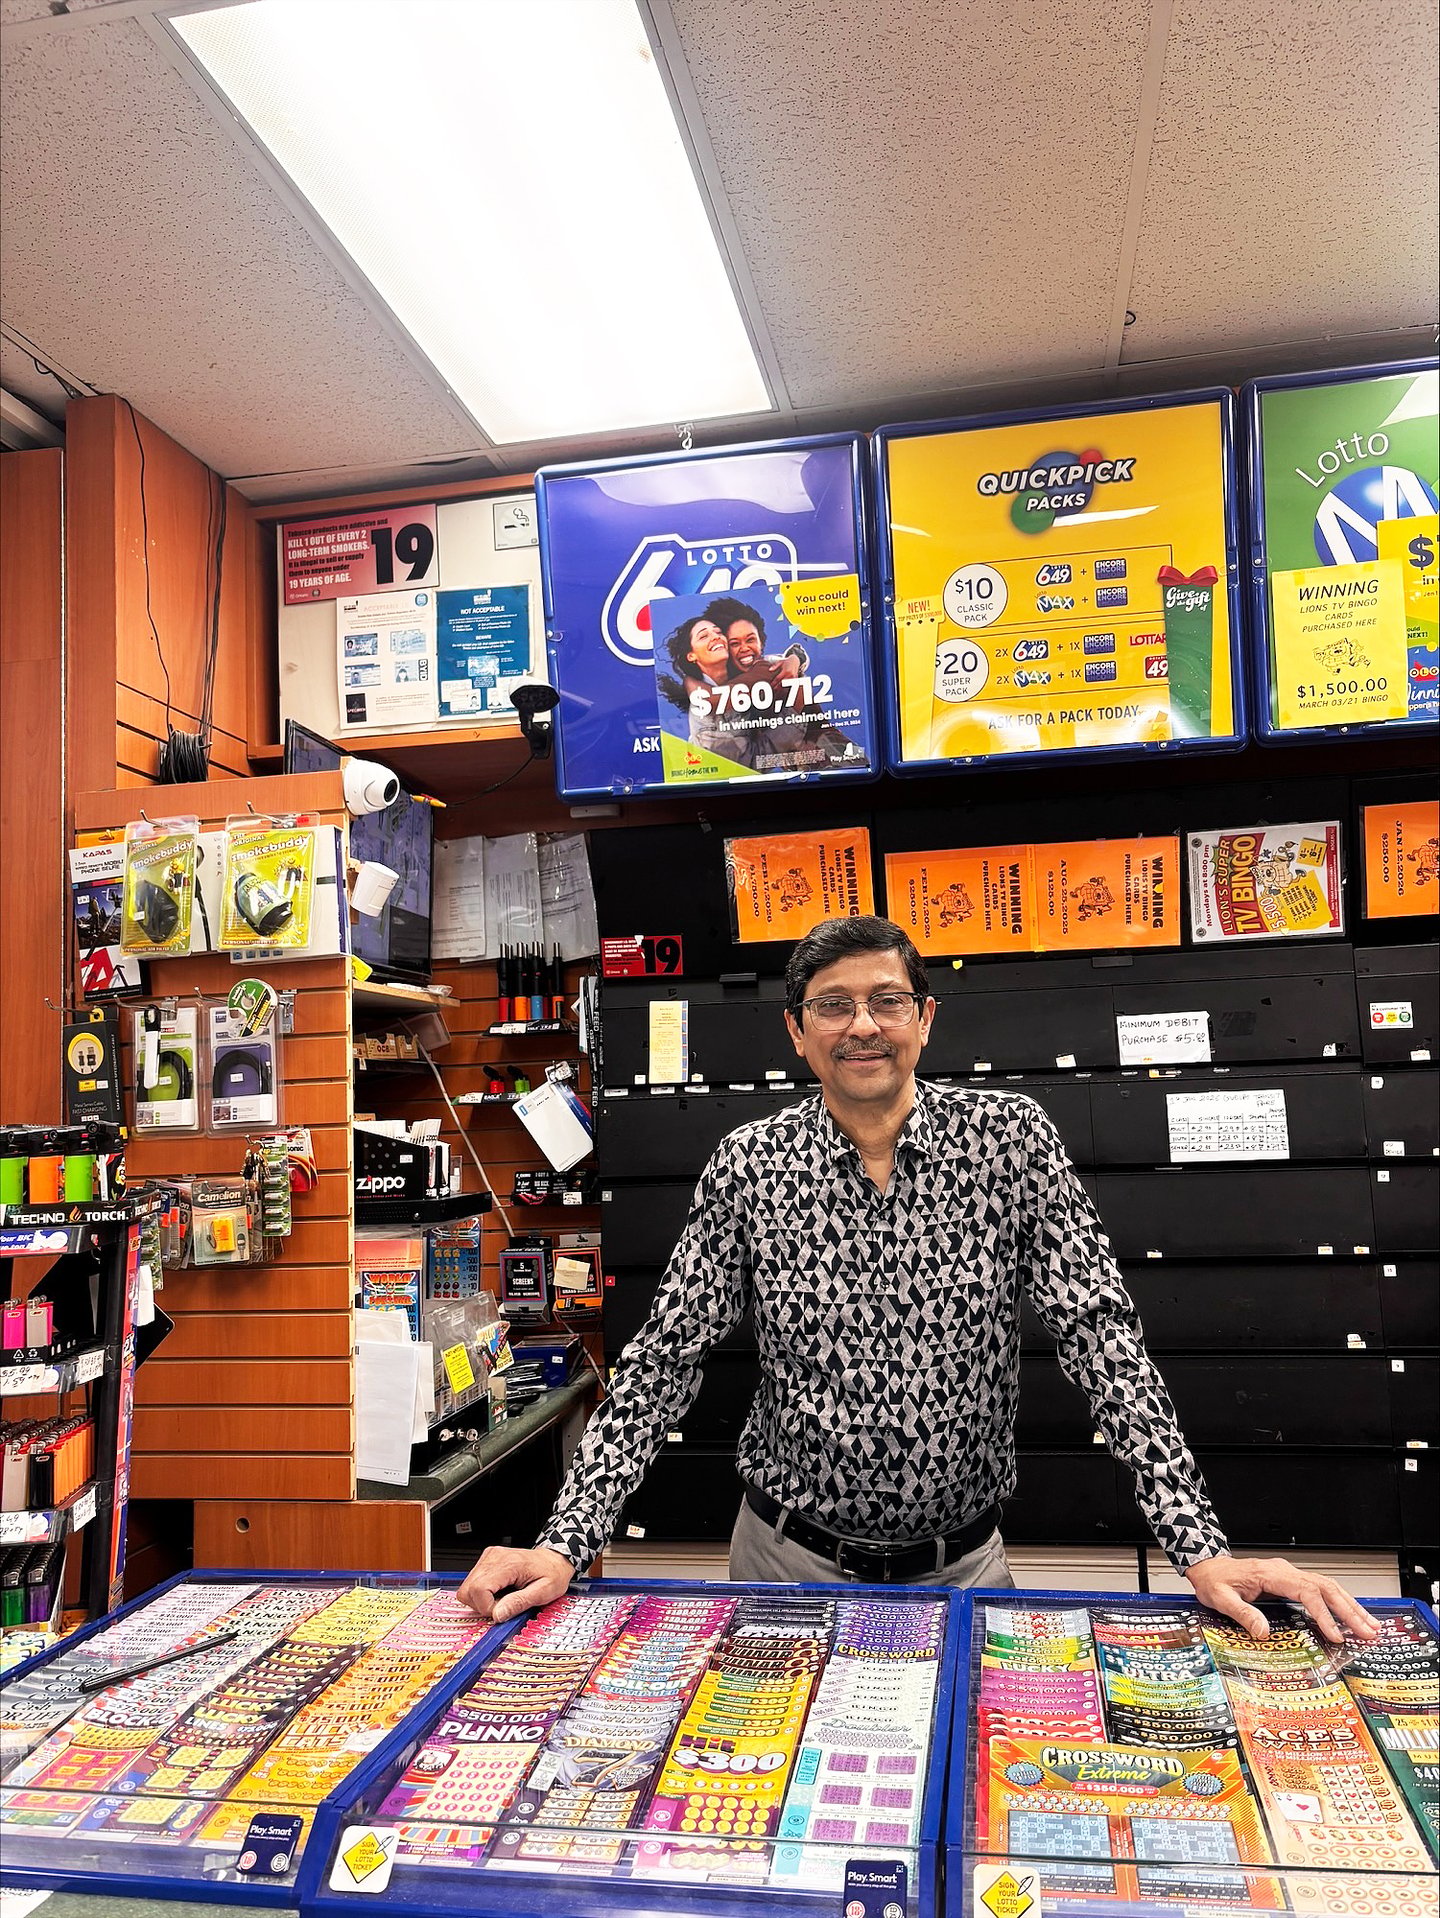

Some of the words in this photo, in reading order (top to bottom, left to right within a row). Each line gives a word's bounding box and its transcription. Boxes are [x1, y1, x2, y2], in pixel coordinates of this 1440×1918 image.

[1296, 431, 1389, 488] Lotto
[978, 458, 1136, 496] QUICKPICK
[1027, 493, 1085, 512] PACKS
[288, 536, 302, 549] KILL
[305, 535, 309, 546] 1
[310, 534, 324, 546] OUT
[327, 533, 336, 544] OF
[337, 530, 360, 543] EVERY
[361, 529, 367, 539] 2
[288, 545, 330, 560] LONG-TERM
[331, 540, 370, 554] SMOKERS.
[371, 523, 434, 584] 19
[686, 543, 773, 567] LOTTO
[1096, 559, 1125, 569] ENCORE
[289, 580, 299, 589] 19
[299, 576, 324, 588] YEARS
[324, 575, 334, 584] OF
[335, 573, 352, 584] AGE.
[1422, 575, 1435, 586] in
[956, 577, 993, 601] $10
[1097, 587, 1126, 596] ENCORE
[1299, 579, 1379, 601] WINNING
[796, 595, 816, 604] You
[819, 590, 849, 601] could
[1037, 595, 1074, 613] MAX
[1166, 587, 1196, 608] Give
[1185, 591, 1211, 612] gift
[472, 605, 505, 614] ACCEPTABLE
[796, 608, 815, 616] win
[819, 602, 846, 613] next!
[908, 600, 930, 614] NEW!
[957, 603, 994, 613] CLASSIC
[1300, 604, 1328, 614] LIONS
[1332, 602, 1345, 610] TV
[1348, 598, 1378, 609] BINGO
[964, 614, 988, 623] PACK
[1325, 612, 1354, 621] CARDS
[1302, 621, 1353, 633] PURCHASED
[1355, 618, 1377, 627] HERE
[1085, 634, 1113, 642] ENCORE
[1407, 631, 1428, 639] NEXT!
[995, 649, 1009, 658] 2X
[1070, 642, 1080, 651] 1X
[935, 651, 978, 675] $20
[1071, 669, 1081, 678] 1X
[1409, 666, 1439, 678] OLG
[942, 677, 971, 687] SUPER
[997, 676, 1009, 685] 2X
[1014, 671, 1051, 688] MAX
[945, 688, 968, 696] PACK
[1297, 677, 1388, 699] $1,500.00
[689, 674, 833, 719] $760,712
[1299, 700, 1328, 710] MARCH
[1331, 697, 1358, 707] 03/21
[1362, 694, 1389, 704] BINGO
[719, 721, 731, 732] in
[732, 716, 783, 731] winnings
[784, 710, 832, 725] claimed
[833, 707, 860, 719] here
[989, 714, 1013, 730] ASK
[1018, 713, 1042, 726] FOR
[1047, 712, 1056, 724] A
[1060, 709, 1094, 723] PACK
[1097, 705, 1139, 720] TODAY
[633, 738, 660, 753] ASK
[82, 849, 112, 858] KAPAS
[231, 836, 308, 862] smokebuddy
[1203, 844, 1209, 858] pm
[819, 844, 828, 891] PURCHASED
[834, 849, 842, 873] LIONS
[1218, 840, 1231, 885] SUPER
[81, 867, 100, 875] PHONE
[1230, 835, 1257, 902] BINGO
[828, 866, 836, 893] CARDS
[836, 873, 843, 883] TV
[844, 846, 859, 916] WINNING
[982, 860, 990, 908] PURCHASED
[998, 866, 1006, 889] LIONS
[1202, 879, 1208, 888] at
[909, 879, 917, 925] $250.00
[1008, 863, 1022, 934] WINNING
[1203, 889, 1212, 927] Mondays
[1219, 889, 1233, 932] LION'S
[1260, 897, 1287, 929] 5,500
[1233, 908, 1261, 933] TV
[641, 937, 681, 974] 19
[1120, 1020, 1160, 1029] MINIMUM
[1164, 1018, 1199, 1028] DEBIT
[1121, 1033, 1168, 1046] PURCHASE
[356, 1175, 405, 1193] zippo
[198, 1190, 240, 1203] Camelion
[9, 1212, 66, 1225] TECHNO
[85, 1211, 129, 1222] TORCH.
[17, 1234, 34, 1242] BIC
[369, 1273, 412, 1285] WORLD
[1113, 1614, 1180, 1623] BIGGER
[1120, 1623, 1185, 1631] BIGGER
[838, 1645, 936, 1659] CROSSWORD
[1001, 1662, 1069, 1672] LUCKY
[1105, 1656, 1206, 1670] $1,000,000
[1122, 1667, 1195, 1680] ULTRA
[12, 1700, 51, 1711] Cash
[24, 1711, 64, 1722] LIFE
[193, 1706, 267, 1724] LUCKY
[458, 1711, 548, 1723] $500,000
[185, 1715, 227, 1732] LINES
[1395, 1718, 1408, 1727] 25
[278, 1735, 347, 1748] CATS
[1252, 1727, 1355, 1742] ACES
[565, 1736, 659, 1750] DIAMOND
[1252, 1738, 1361, 1751] WILD
[571, 1750, 636, 1788] 7
[672, 1749, 787, 1775] $300
[1042, 1747, 1186, 1777] CROSSWORD
[1077, 1765, 1152, 1782] Extreme
[1086, 1784, 1144, 1794] $350,000
[268, 1826, 293, 1836] Smart
[869, 1873, 898, 1884] Smart
[997, 1898, 1018, 1906] LOTTO
[996, 1906, 1018, 1914] TICKET
